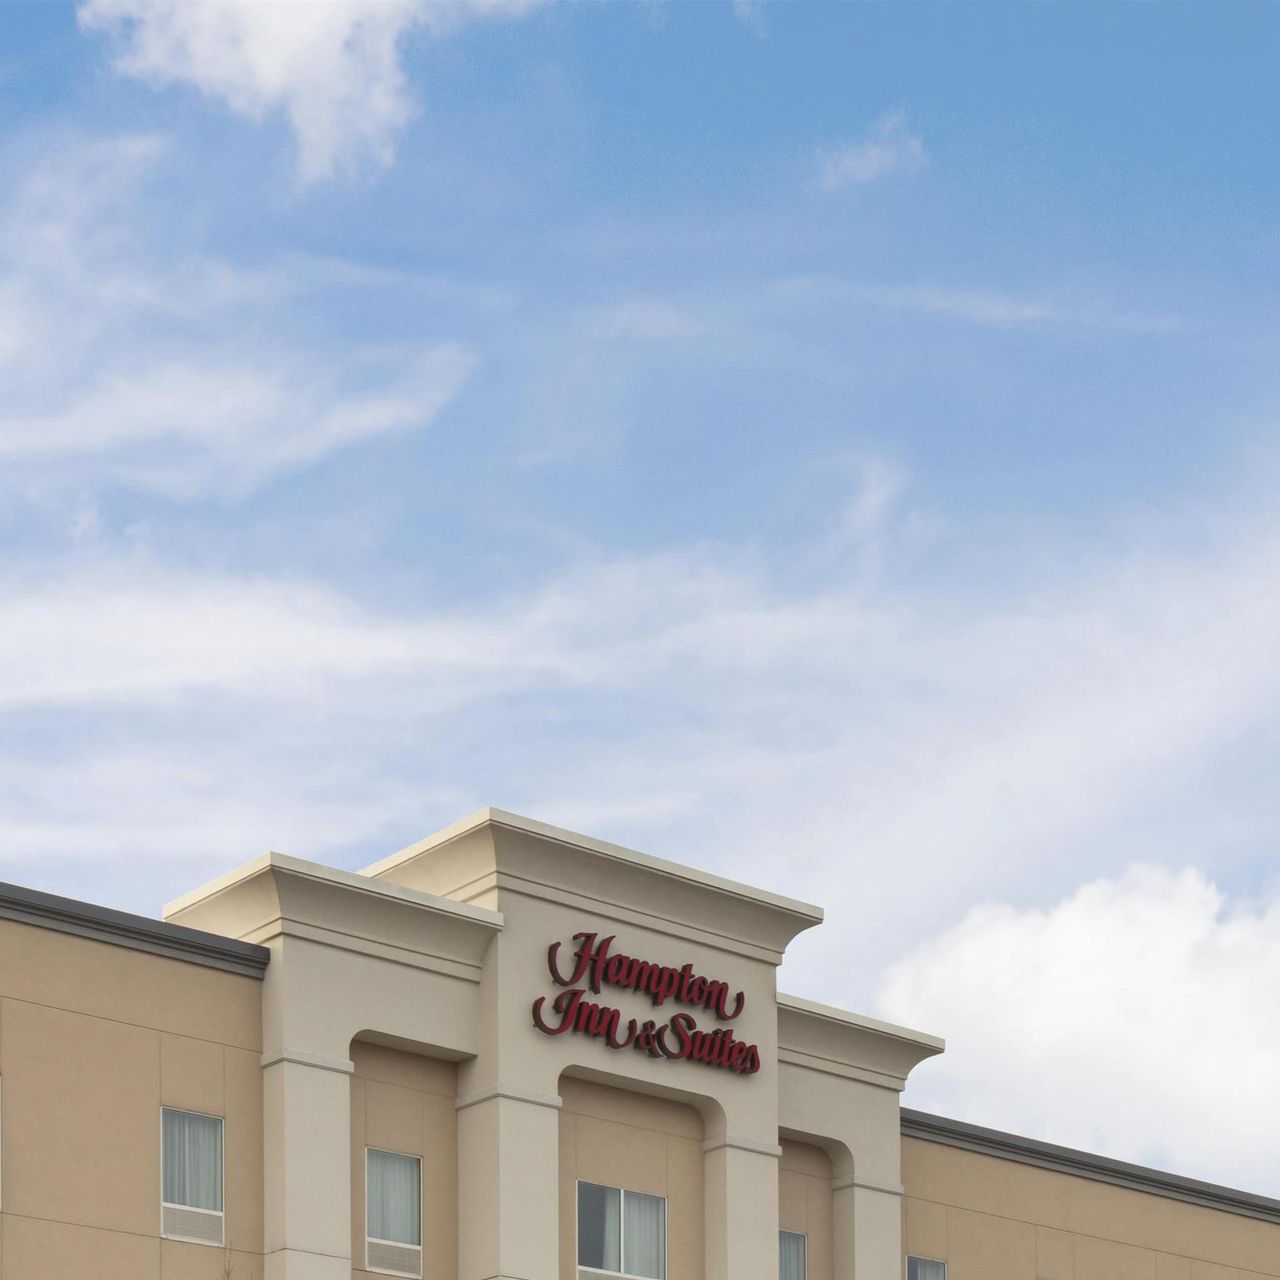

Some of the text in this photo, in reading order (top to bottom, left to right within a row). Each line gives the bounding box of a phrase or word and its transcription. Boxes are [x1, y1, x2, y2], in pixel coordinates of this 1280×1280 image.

[548, 932, 745, 1021] Hampton
[532, 989, 761, 1075] Inn & Suites
